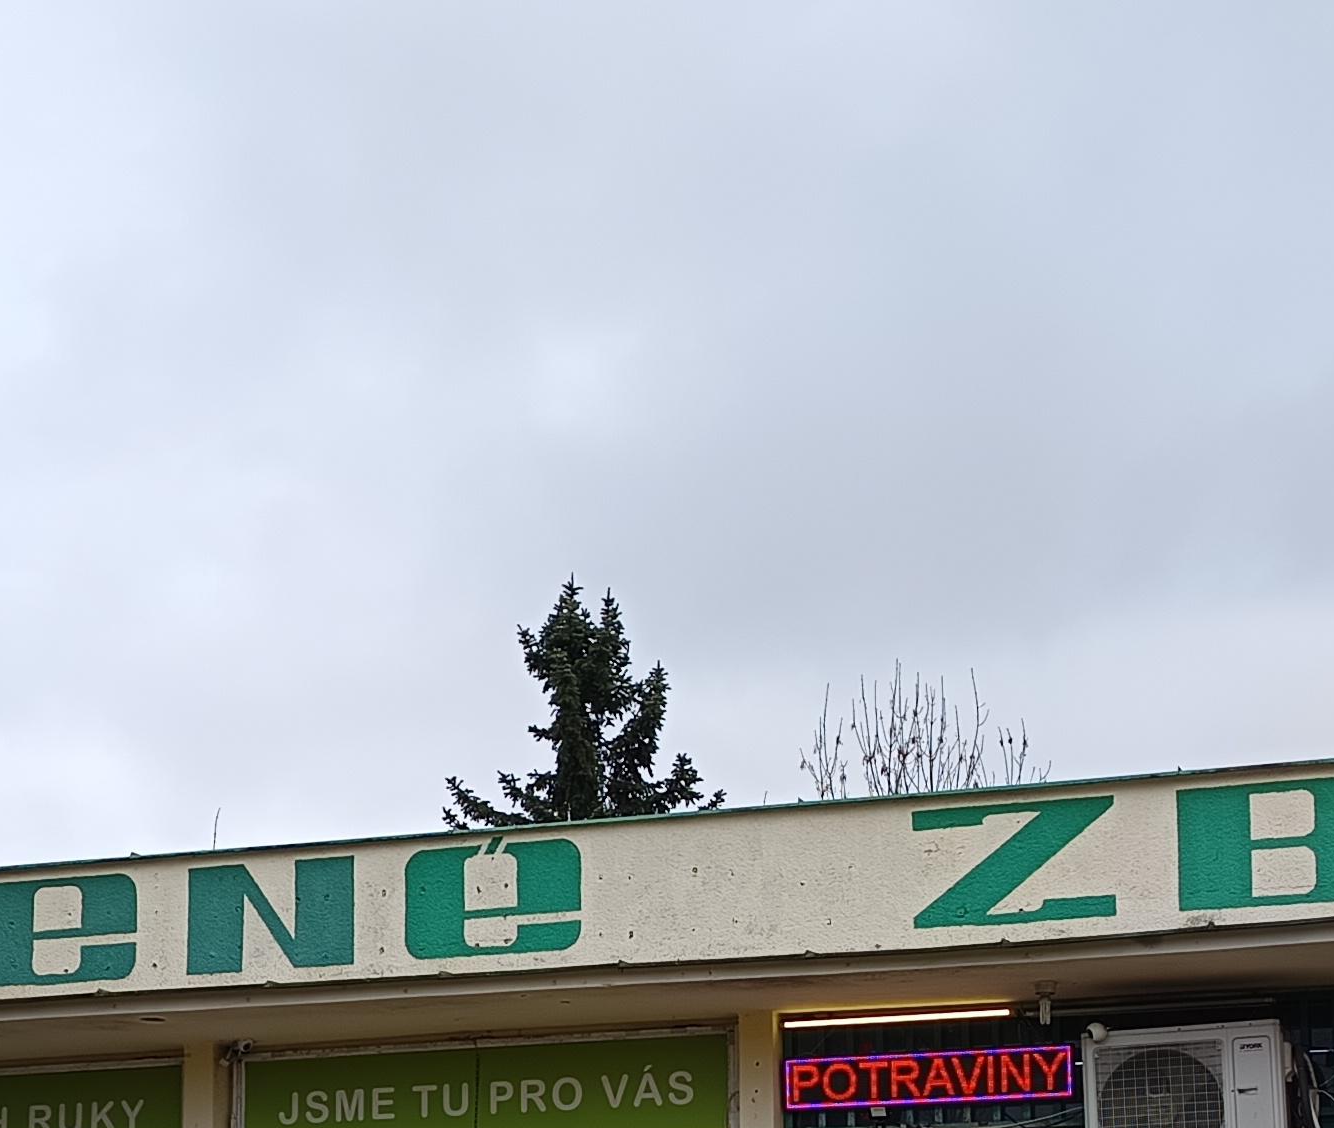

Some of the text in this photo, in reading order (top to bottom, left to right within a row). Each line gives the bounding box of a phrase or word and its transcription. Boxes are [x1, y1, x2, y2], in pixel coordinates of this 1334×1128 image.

[278, 1064, 697, 1126] JSME TU PRO VÁS
[790, 1051, 1067, 1103] POTRAVINY
